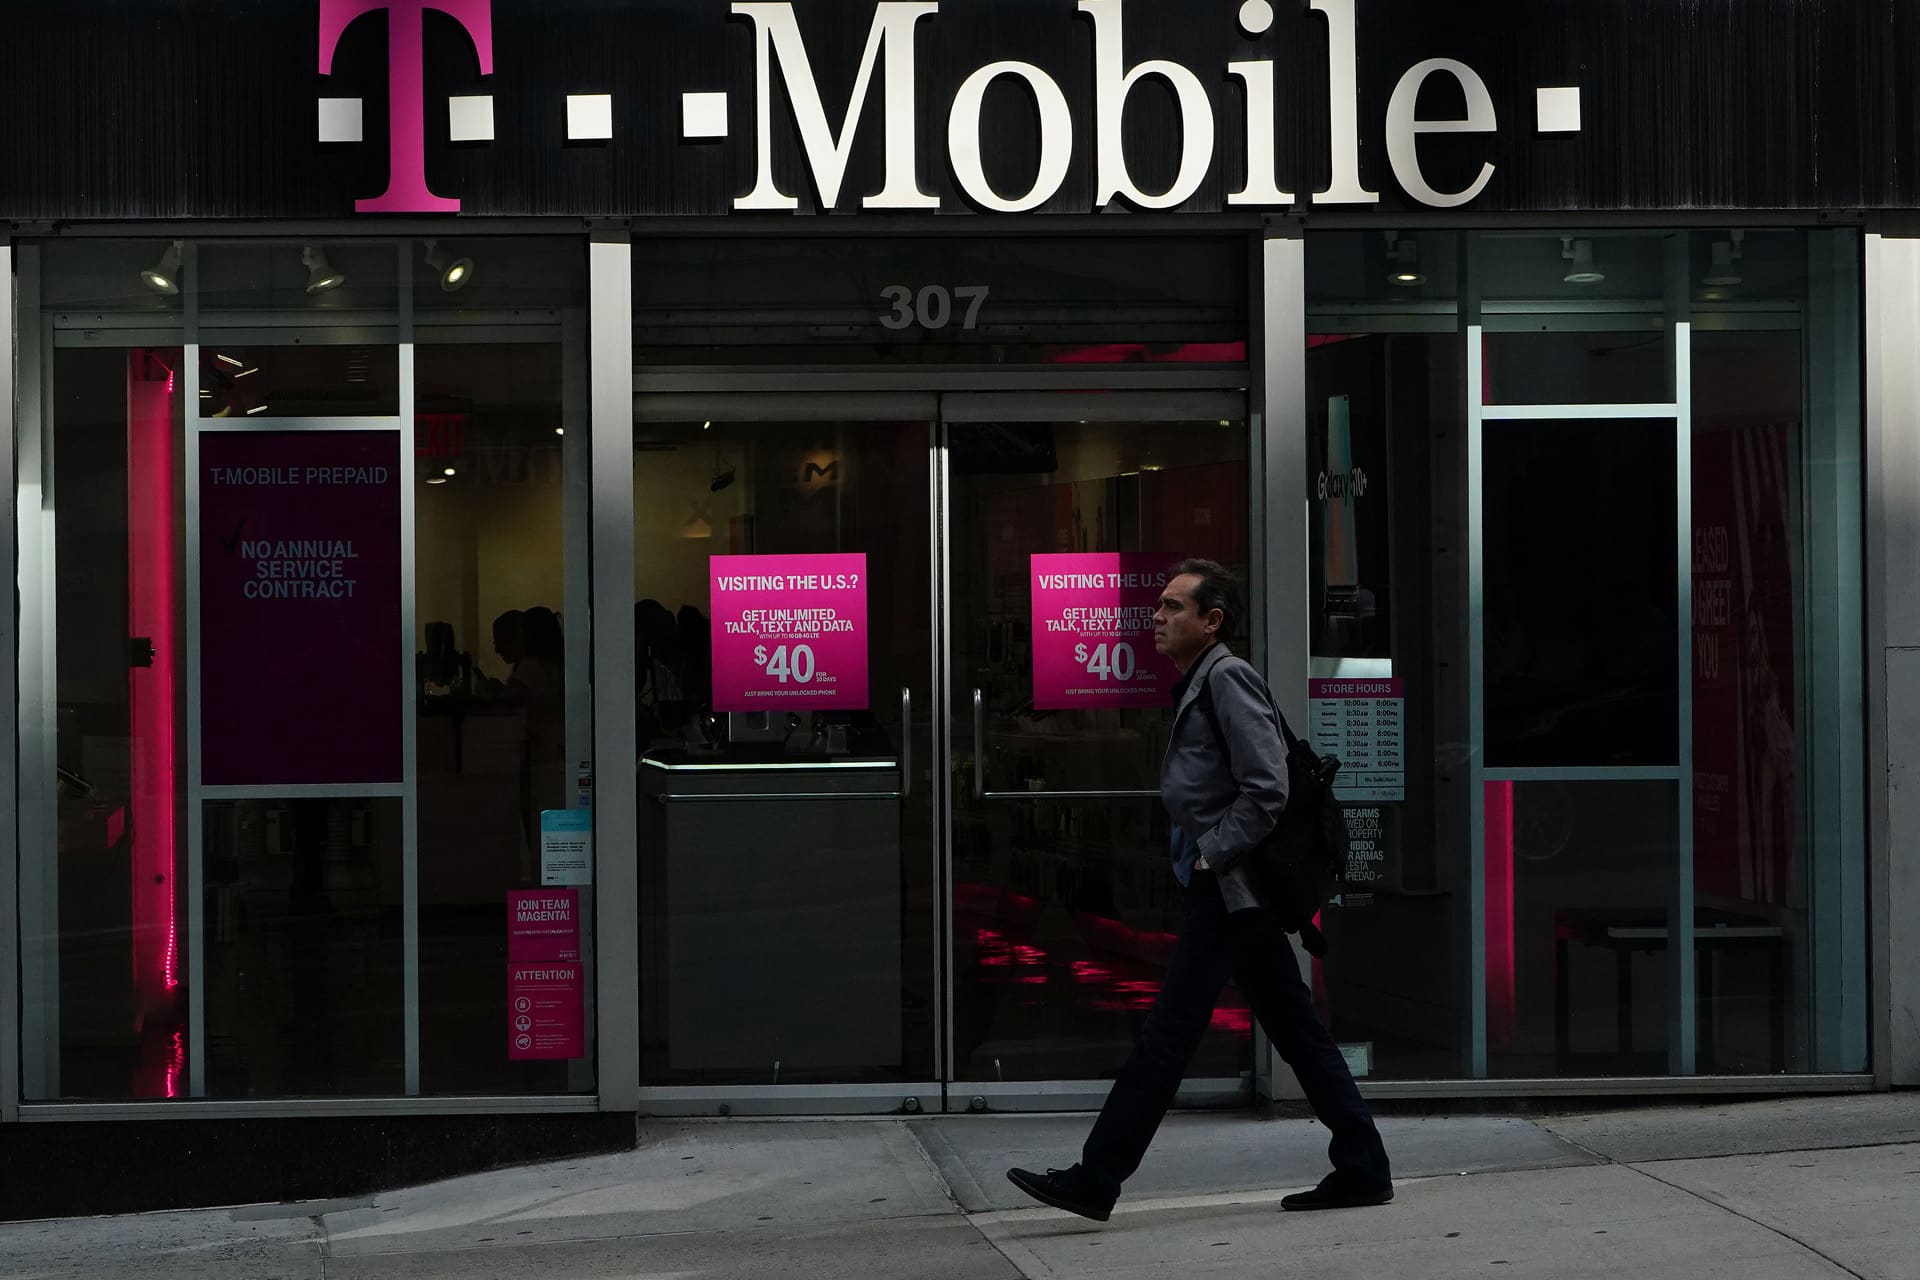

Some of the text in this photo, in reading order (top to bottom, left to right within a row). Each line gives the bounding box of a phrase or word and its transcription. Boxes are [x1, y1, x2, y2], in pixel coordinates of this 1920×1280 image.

[879, 284, 990, 330] 307
[209, 465, 389, 486] T-MOBILE PREPAID
[242, 540, 359, 559] NO ANNUAL
[1692, 526, 1729, 573] EASED
[256, 559, 344, 579] SERVICE
[243, 579, 358, 599] CONTRACT
[717, 574, 860, 592] VISITING THE U.S.?
[1039, 572, 1167, 590] VISITING THE U.S
[741, 608, 836, 622] GET UNLIMITED
[1062, 606, 1156, 620] GET UNLIMITED
[724, 618, 855, 635] TALK, TEXT AND DATA
[1045, 617, 1158, 633] TALK, TEXT AND DA
[753, 644, 815, 684] $40
[1074, 642, 1136, 681] $40
[1320, 683, 1392, 694] STORE HOURS
[1343, 808, 1380, 818] IREARMS
[1366, 819, 1378, 829] ON
[1355, 851, 1384, 861] ARMAS
[1350, 861, 1369, 871] ESTA
[517, 898, 570, 911] JOIN TEAM
[517, 910, 570, 922] MAGENTA!
[514, 969, 575, 981] ATTENTION
